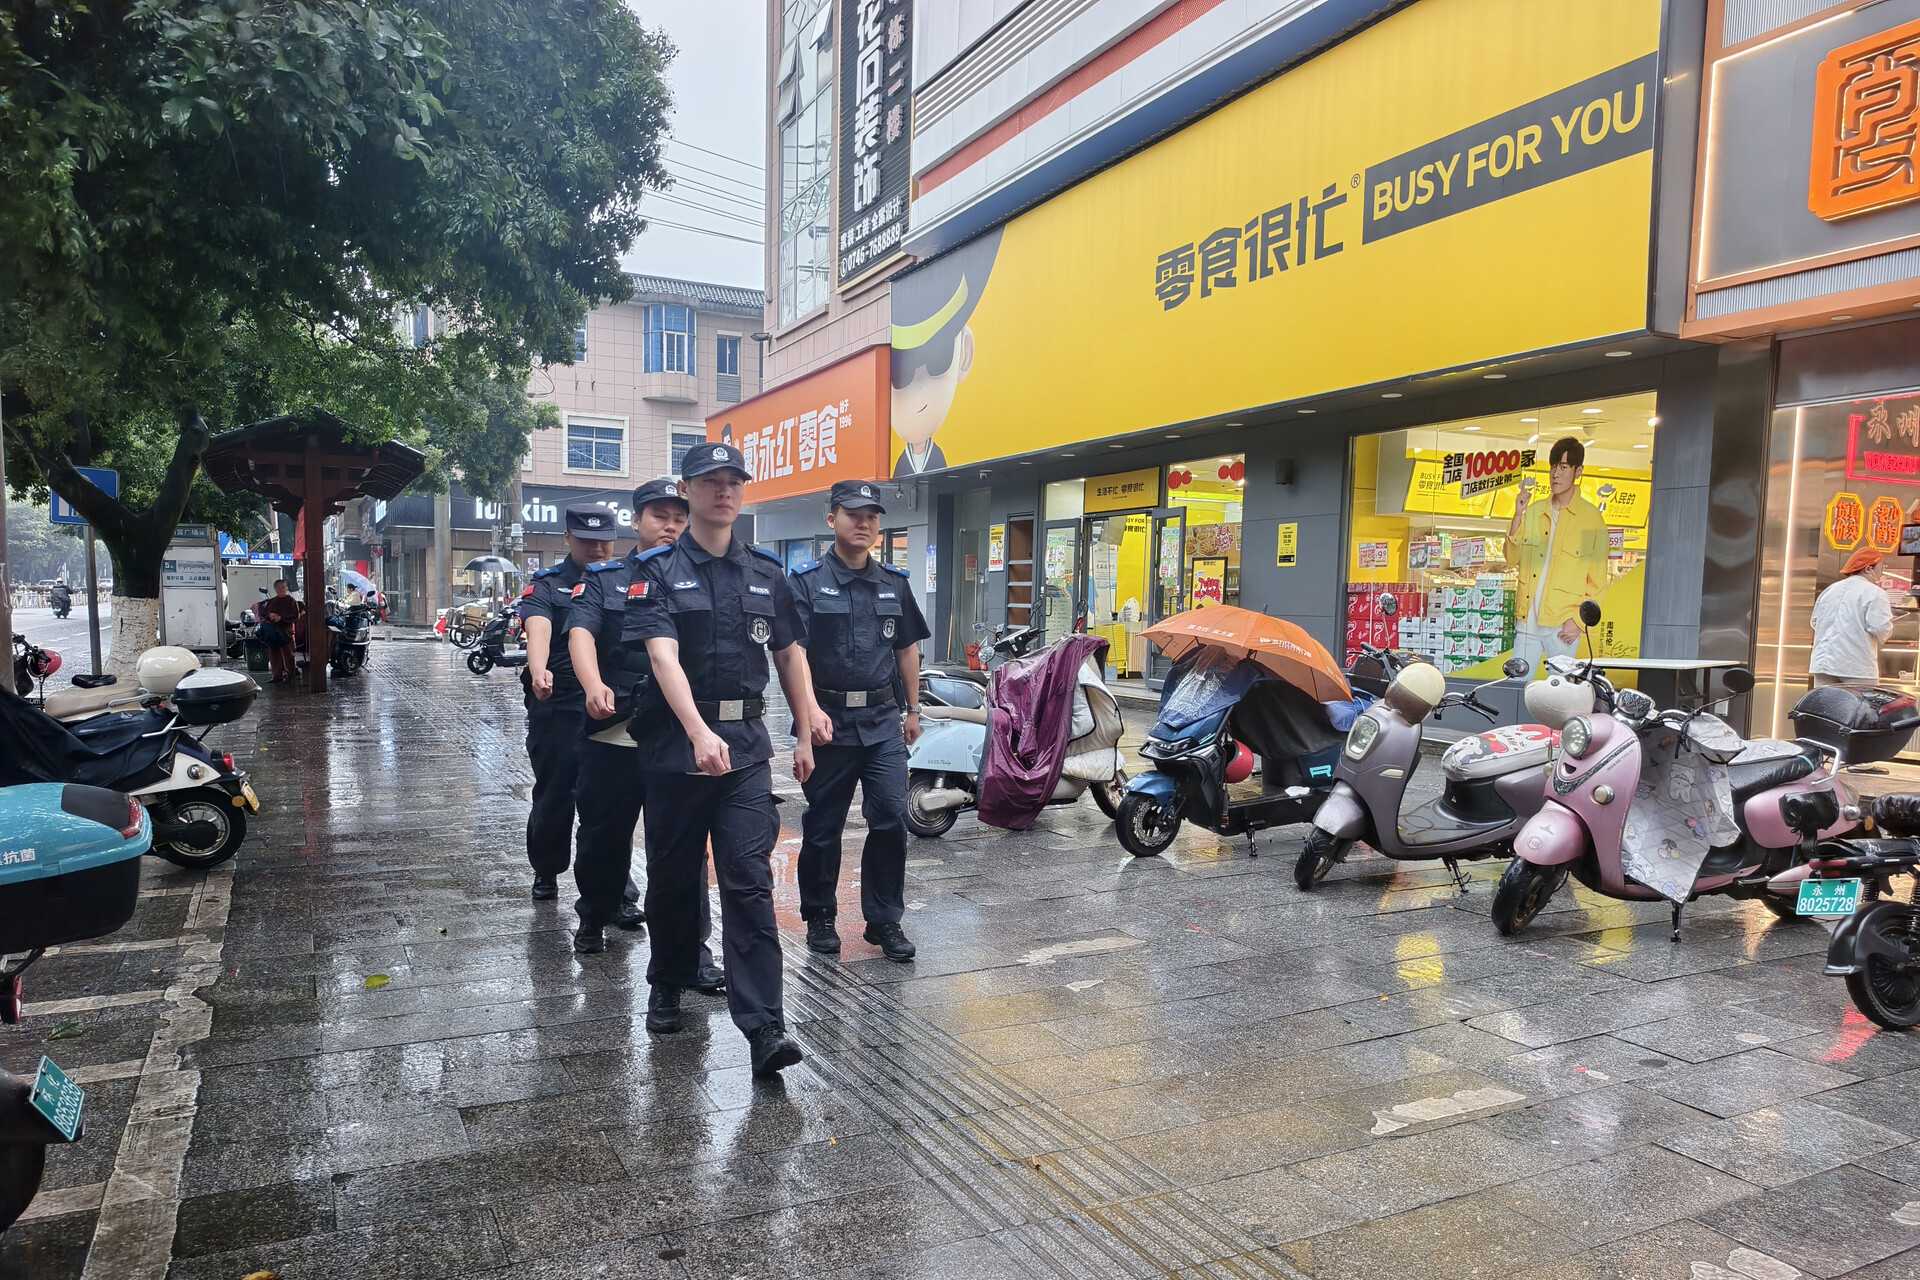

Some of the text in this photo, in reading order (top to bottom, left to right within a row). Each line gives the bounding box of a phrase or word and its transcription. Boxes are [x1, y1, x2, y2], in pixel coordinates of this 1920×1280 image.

[1372, 82, 1645, 221] BUSY FOR YOU
[855, 216, 870, 241] 工装
[1154, 182, 1348, 311] 零食很忙
[839, 398, 850, 414] 始于
[839, 413, 852, 429] 1996
[743, 404, 839, 485] 戴永红 零食
[1443, 452, 1465, 469] 全国
[1465, 449, 1521, 480] 10000
[1520, 449, 1537, 468] 家
[1441, 468, 1463, 486] 门店
[1461, 473, 1522, 497] 门店数行业第一
[1096, 485, 1118, 497] 生活不忙
[1610, 491, 1637, 506] 人民的
[476, 496, 558, 523] lukin
[1606, 621, 1614, 646] 周杰伦
[0, 848, 36, 866] 抗菌
[1811, 884, 1847, 896] 永州
[1799, 896, 1854, 912] 8025728
